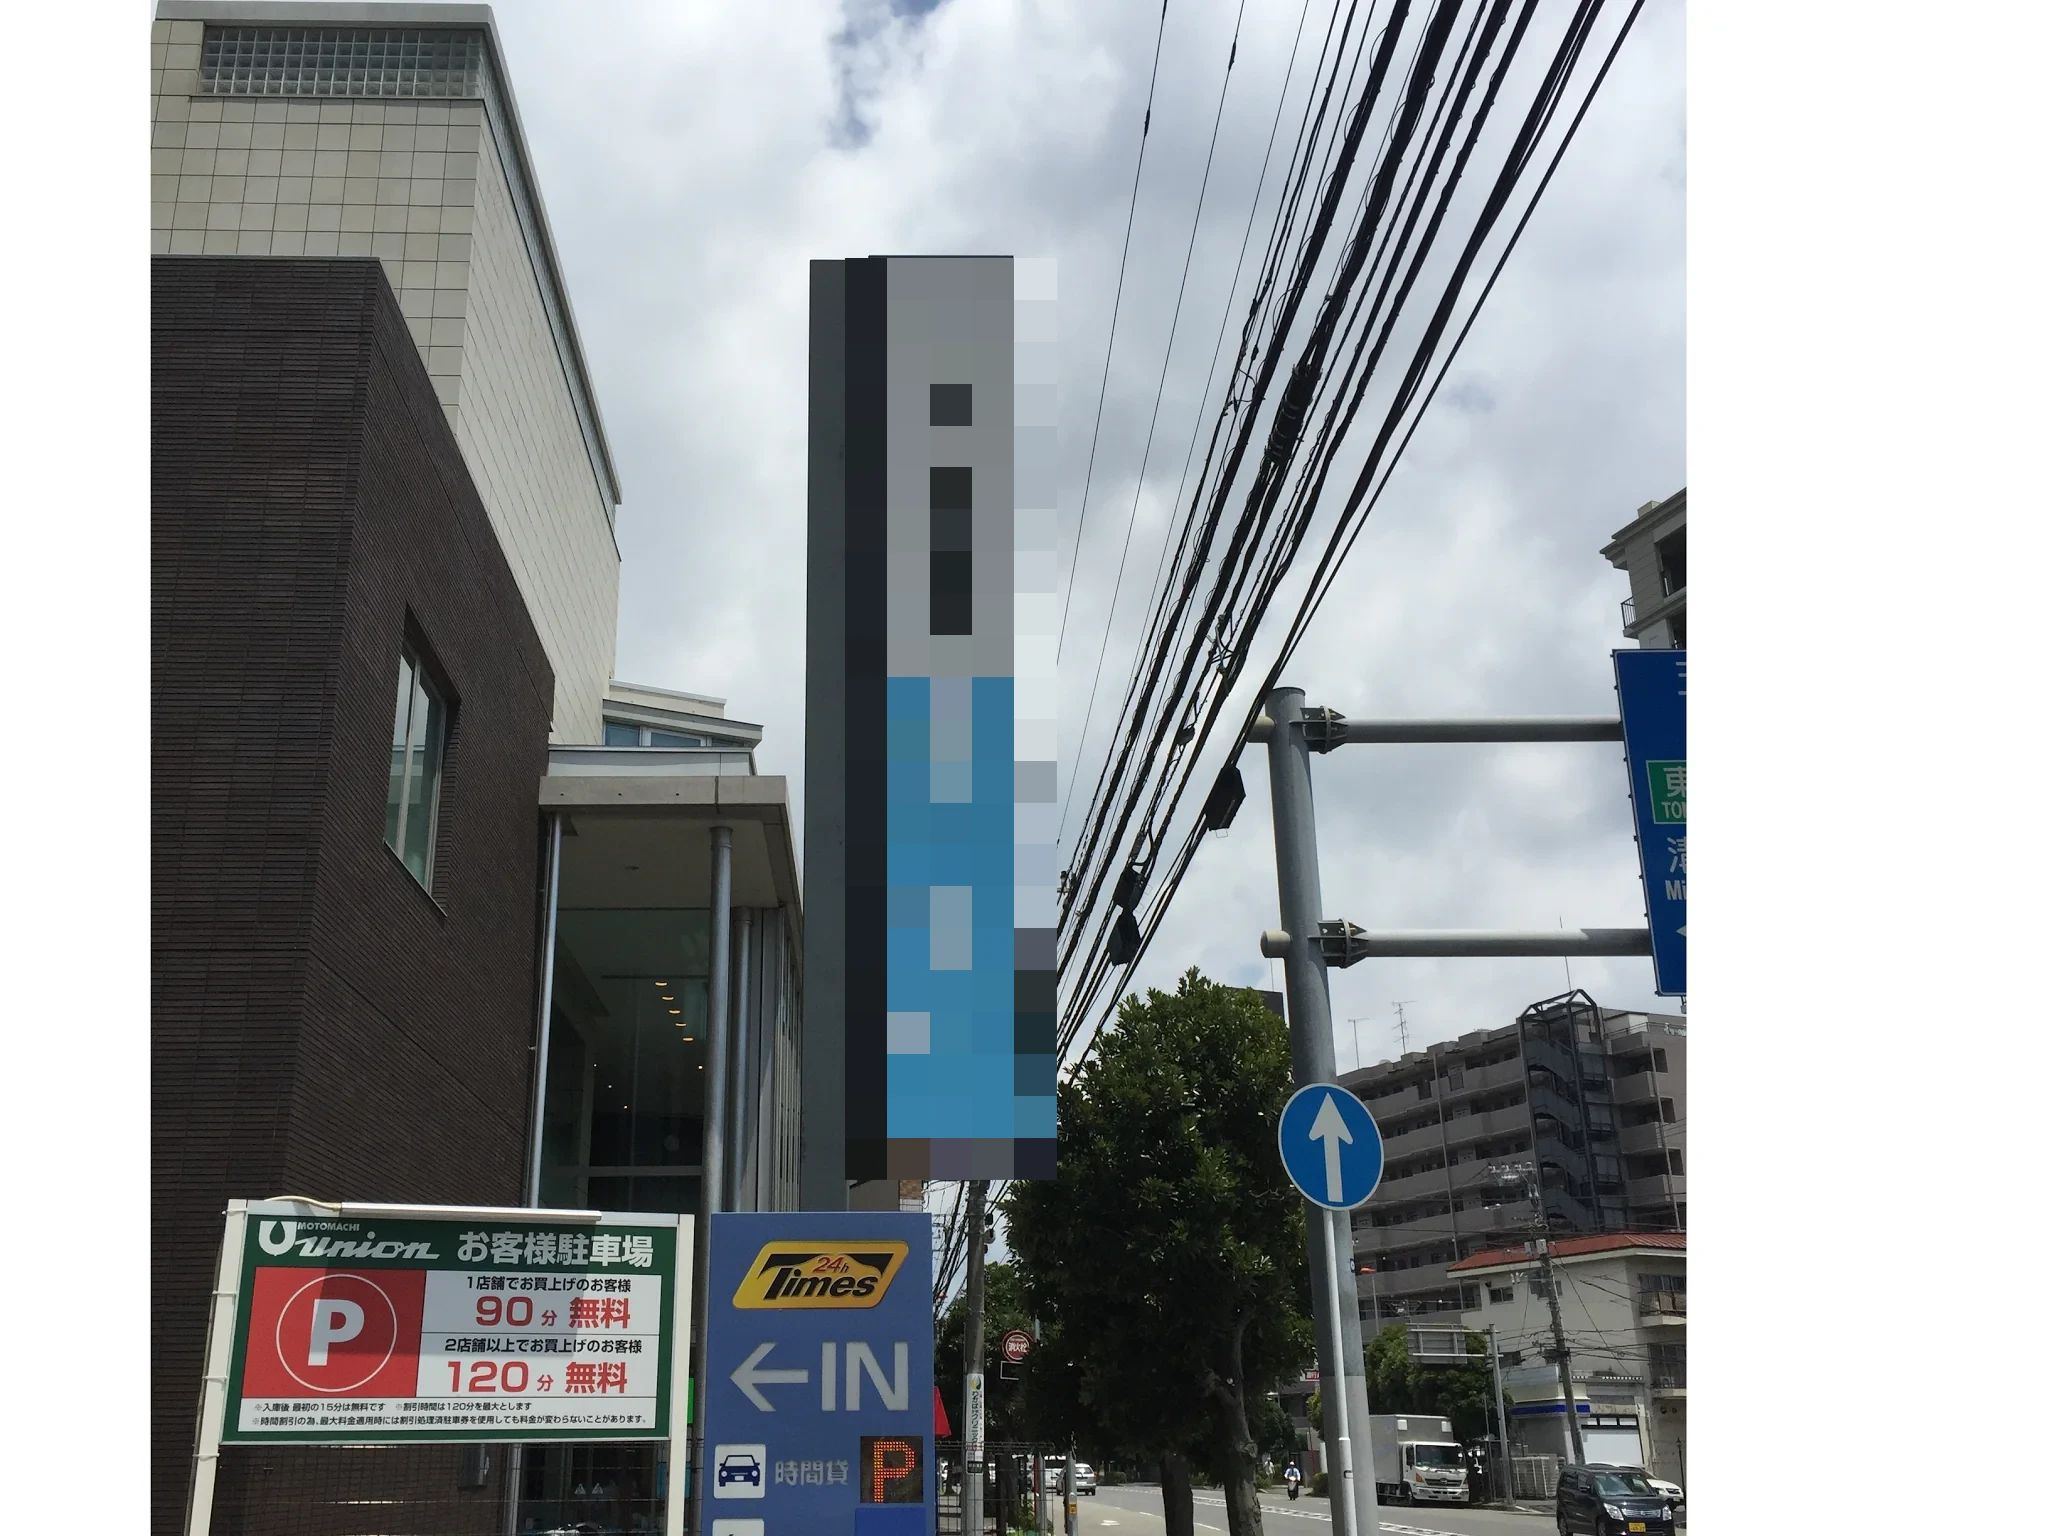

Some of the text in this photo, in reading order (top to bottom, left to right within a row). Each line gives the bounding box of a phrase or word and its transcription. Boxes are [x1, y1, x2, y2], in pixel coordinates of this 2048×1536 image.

[1661, 801, 1687, 819] TO
[297, 1221, 360, 1232] MOTOMACHI
[457, 1231, 654, 1268] お客様駐車場
[813, 1256, 850, 1274] 24h
[467, 1275, 632, 1293] 1店舗でお買上げのお客様
[763, 1267, 879, 1300] Times
[475, 1295, 631, 1329] 90 分 無料
[308, 1298, 365, 1367] P
[444, 1337, 643, 1354] 2店舗以上でお買上げのお客様
[447, 1360, 628, 1394] 120 分 無料
[821, 1342, 909, 1412] IN
[775, 1459, 849, 1486] 時間貸
[873, 1441, 916, 1503] P
